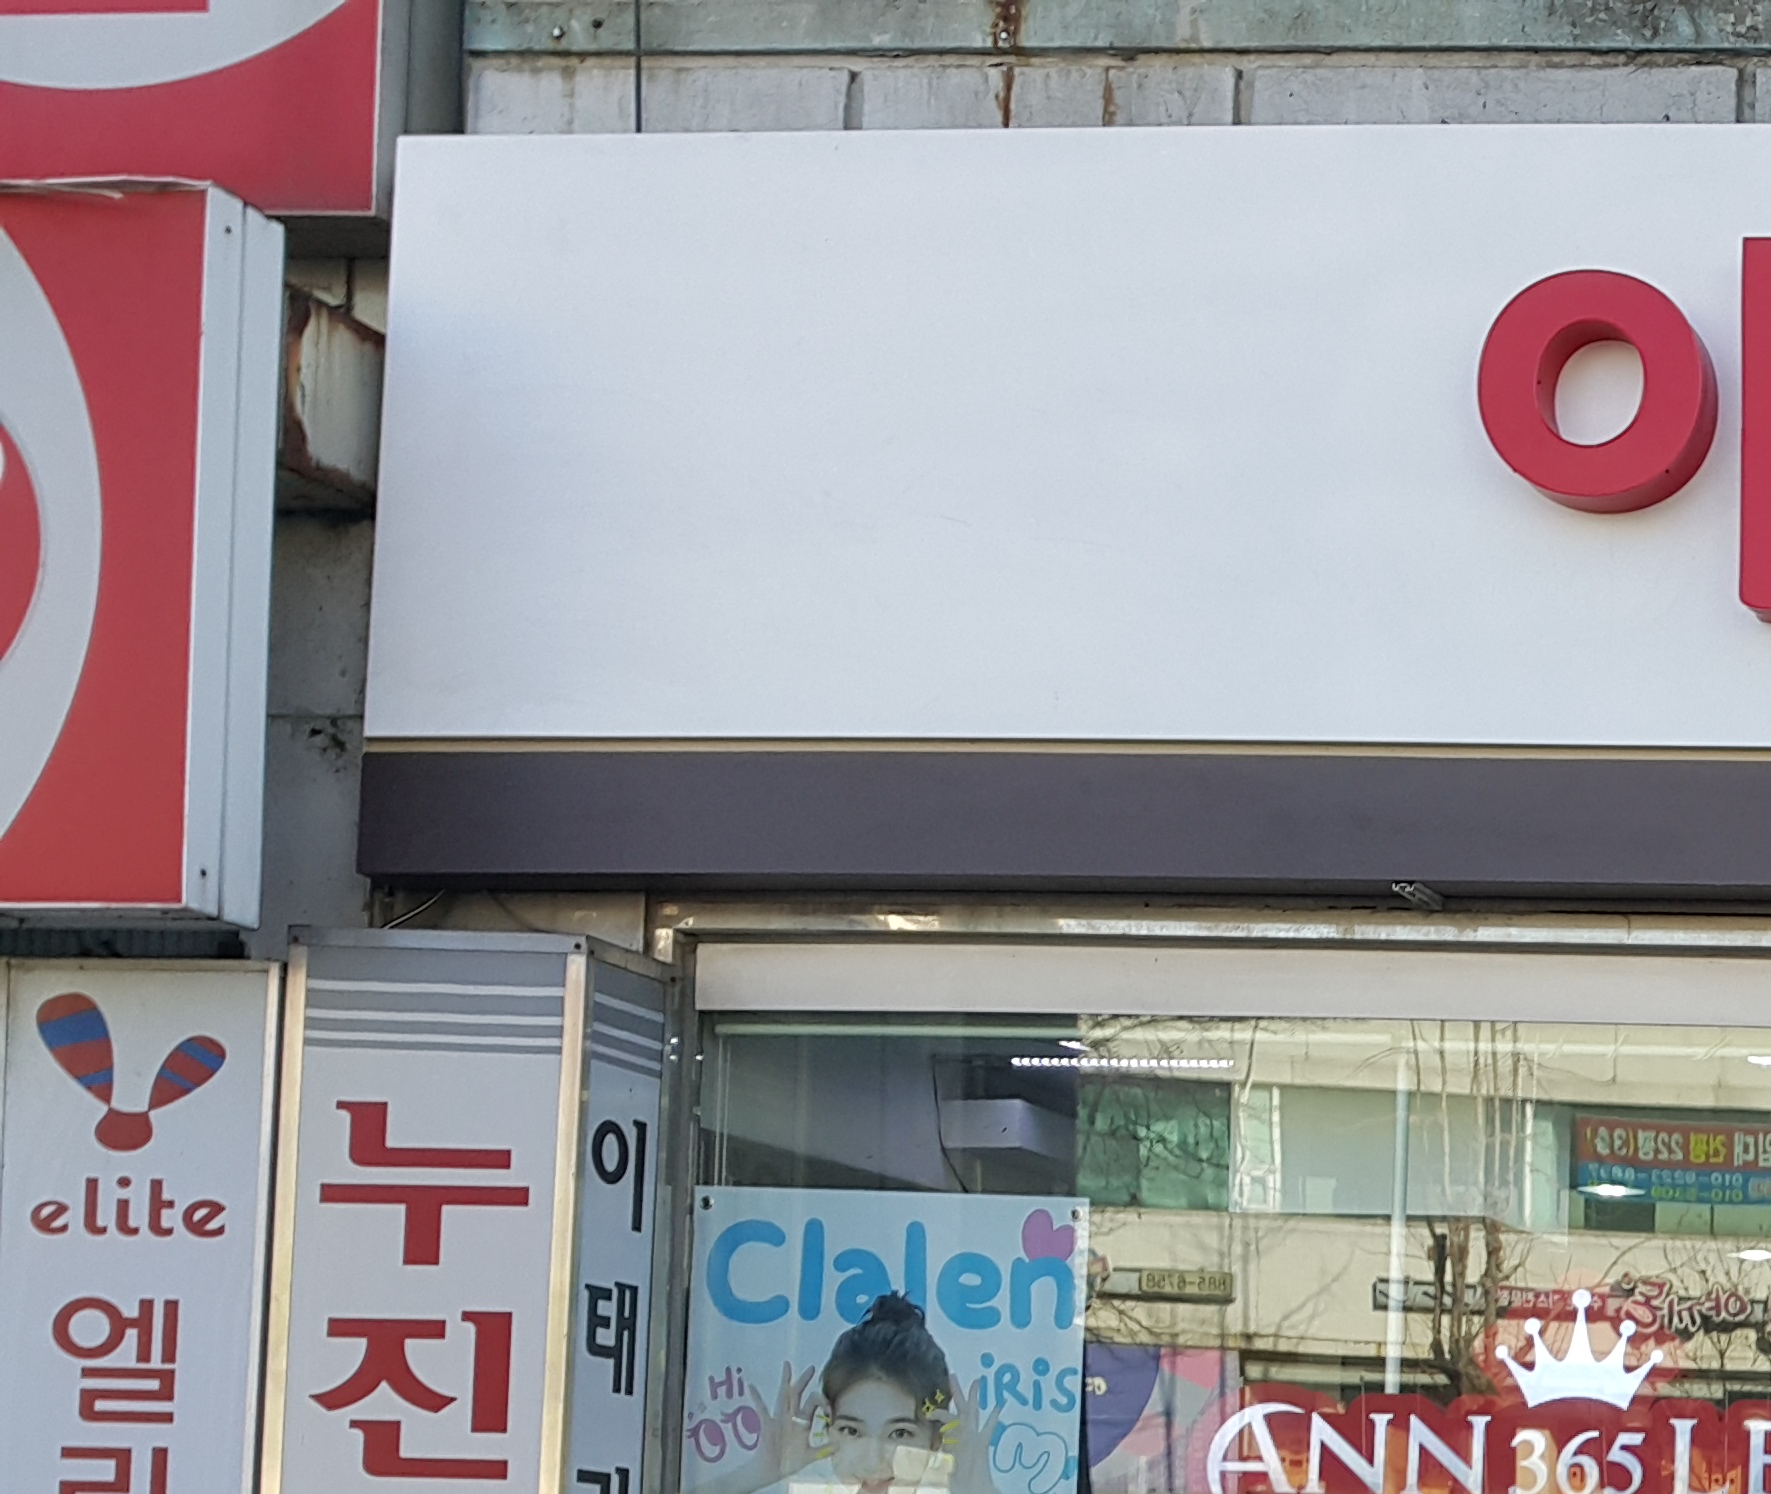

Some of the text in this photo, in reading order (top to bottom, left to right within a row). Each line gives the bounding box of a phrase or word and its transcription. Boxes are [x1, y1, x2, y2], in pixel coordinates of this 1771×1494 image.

[30, 1175, 227, 1238] elite
[706, 1216, 1076, 1331] Clalen
[708, 1365, 745, 1400] Hi
